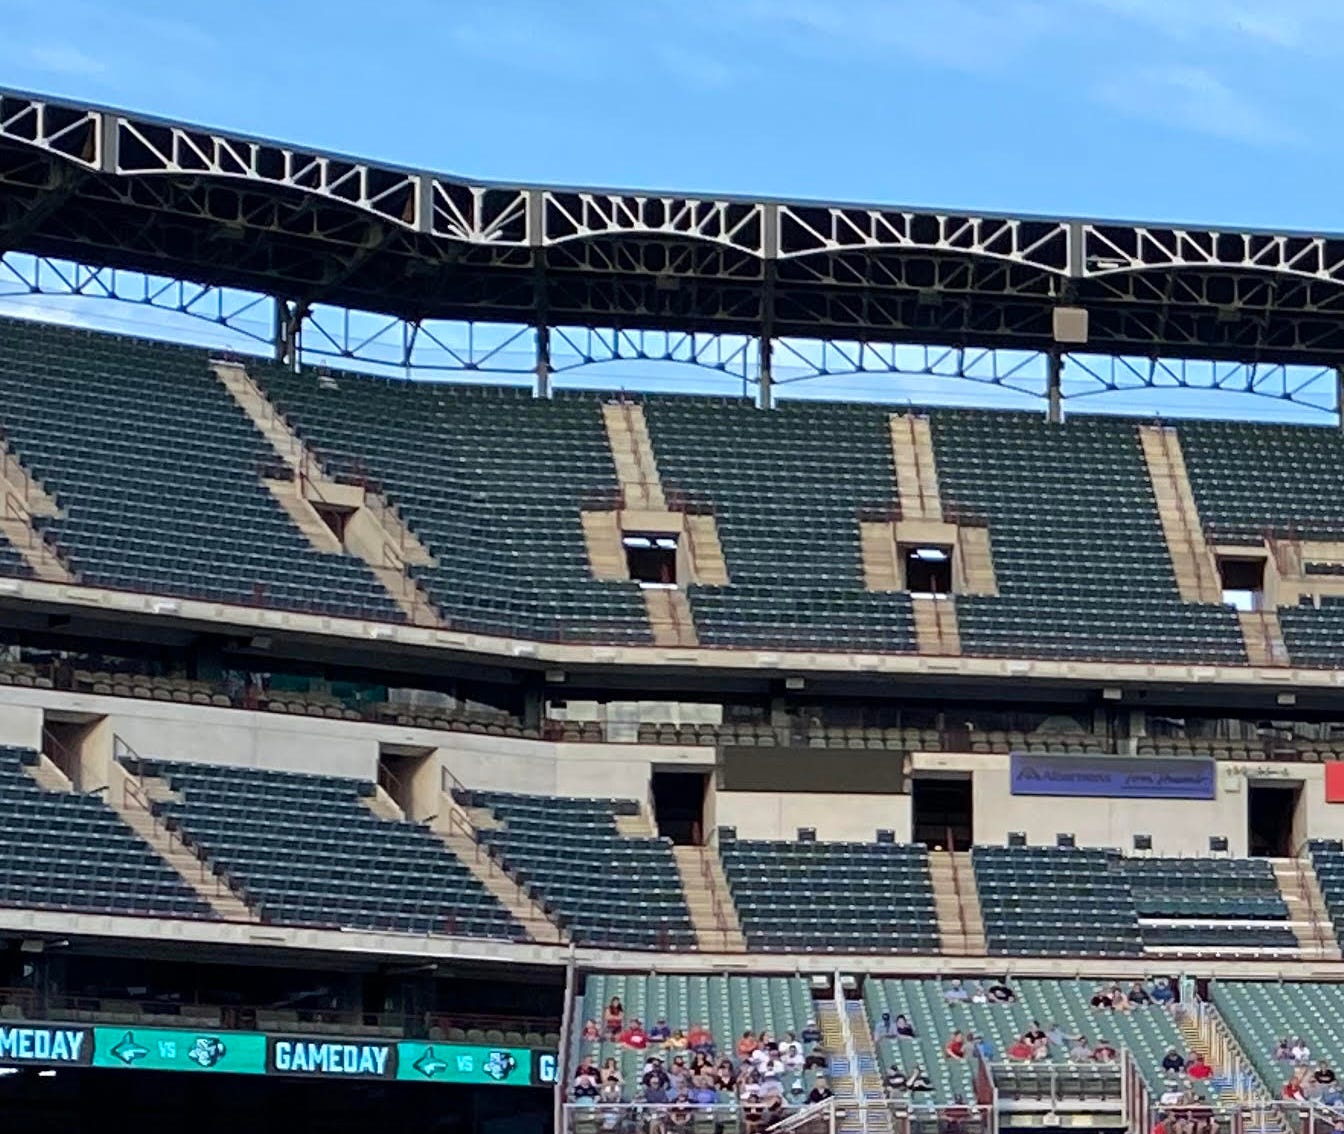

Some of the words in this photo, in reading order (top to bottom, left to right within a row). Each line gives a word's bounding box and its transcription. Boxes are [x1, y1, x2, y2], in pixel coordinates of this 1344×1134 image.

[158, 1040, 176, 1059] VS
[275, 1042, 387, 1075] GAMEDAY
[457, 1054, 473, 1073] VS
